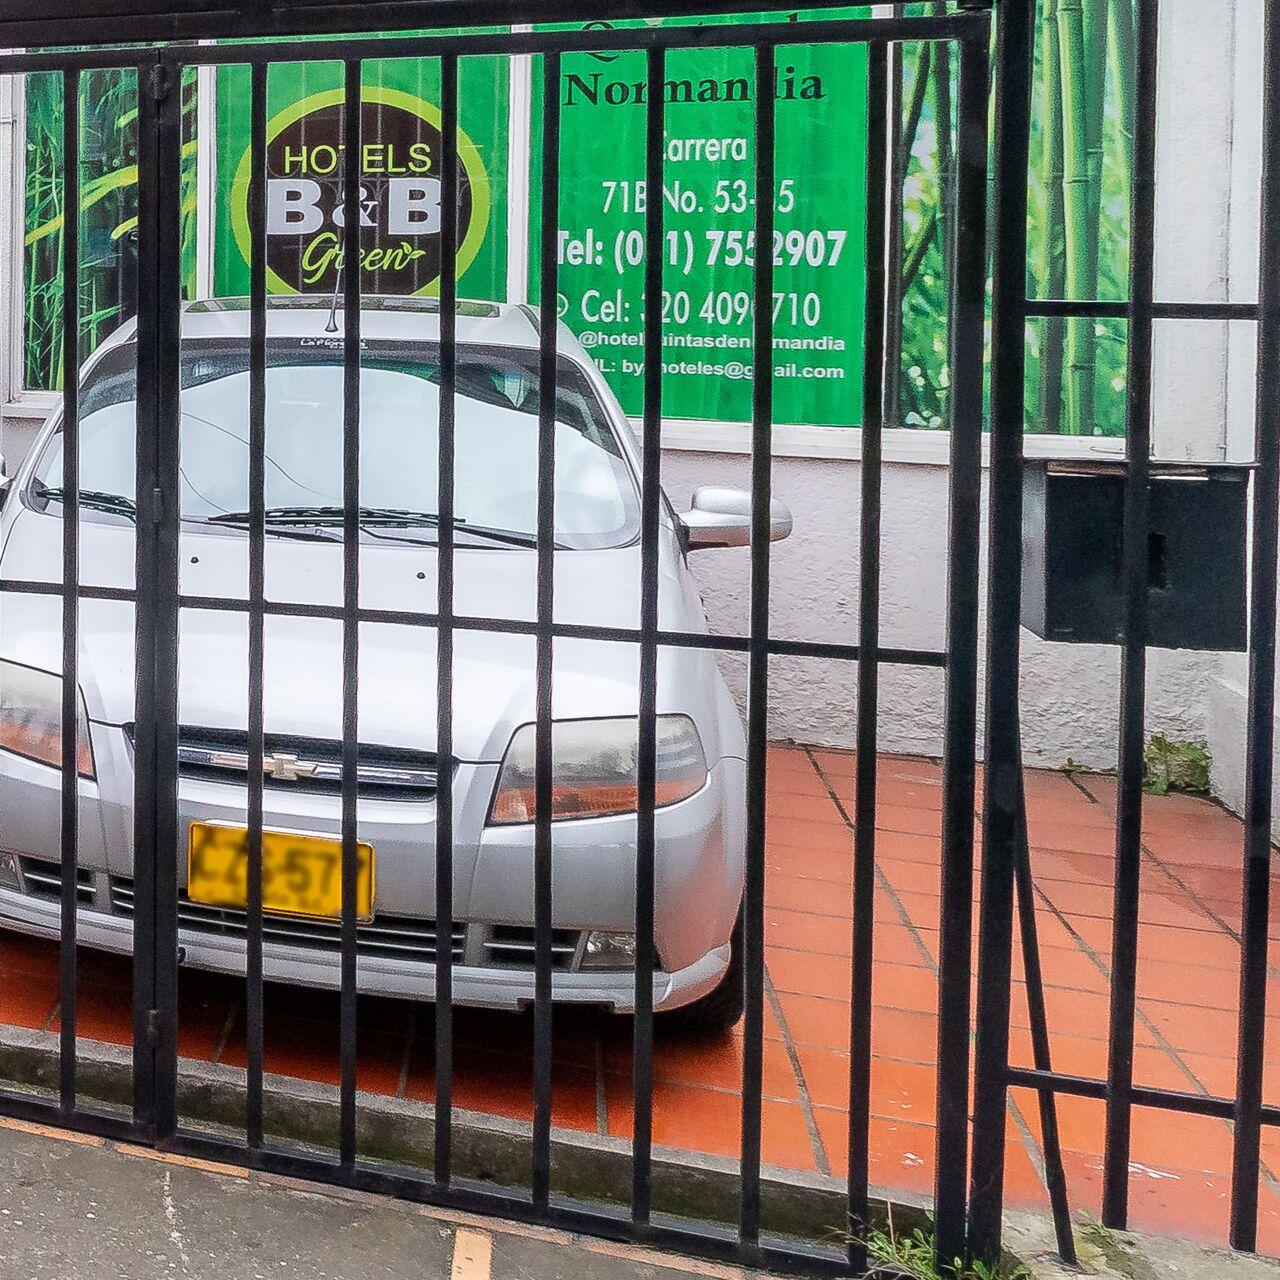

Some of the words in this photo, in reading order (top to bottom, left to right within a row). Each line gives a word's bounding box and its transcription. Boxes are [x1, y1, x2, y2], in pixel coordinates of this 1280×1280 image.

[562, 66, 827, 108] Normania
[659, 130, 748, 162] arrera
[267, 177, 442, 235] B&B
[714, 179, 795, 214] 53-5
[556, 228, 604, 266] Tel:
[614, 230, 694, 275] (01)
[581, 288, 630, 322] Cel:
[640, 290, 690, 324] 20
[699, 291, 821, 327] 409710
